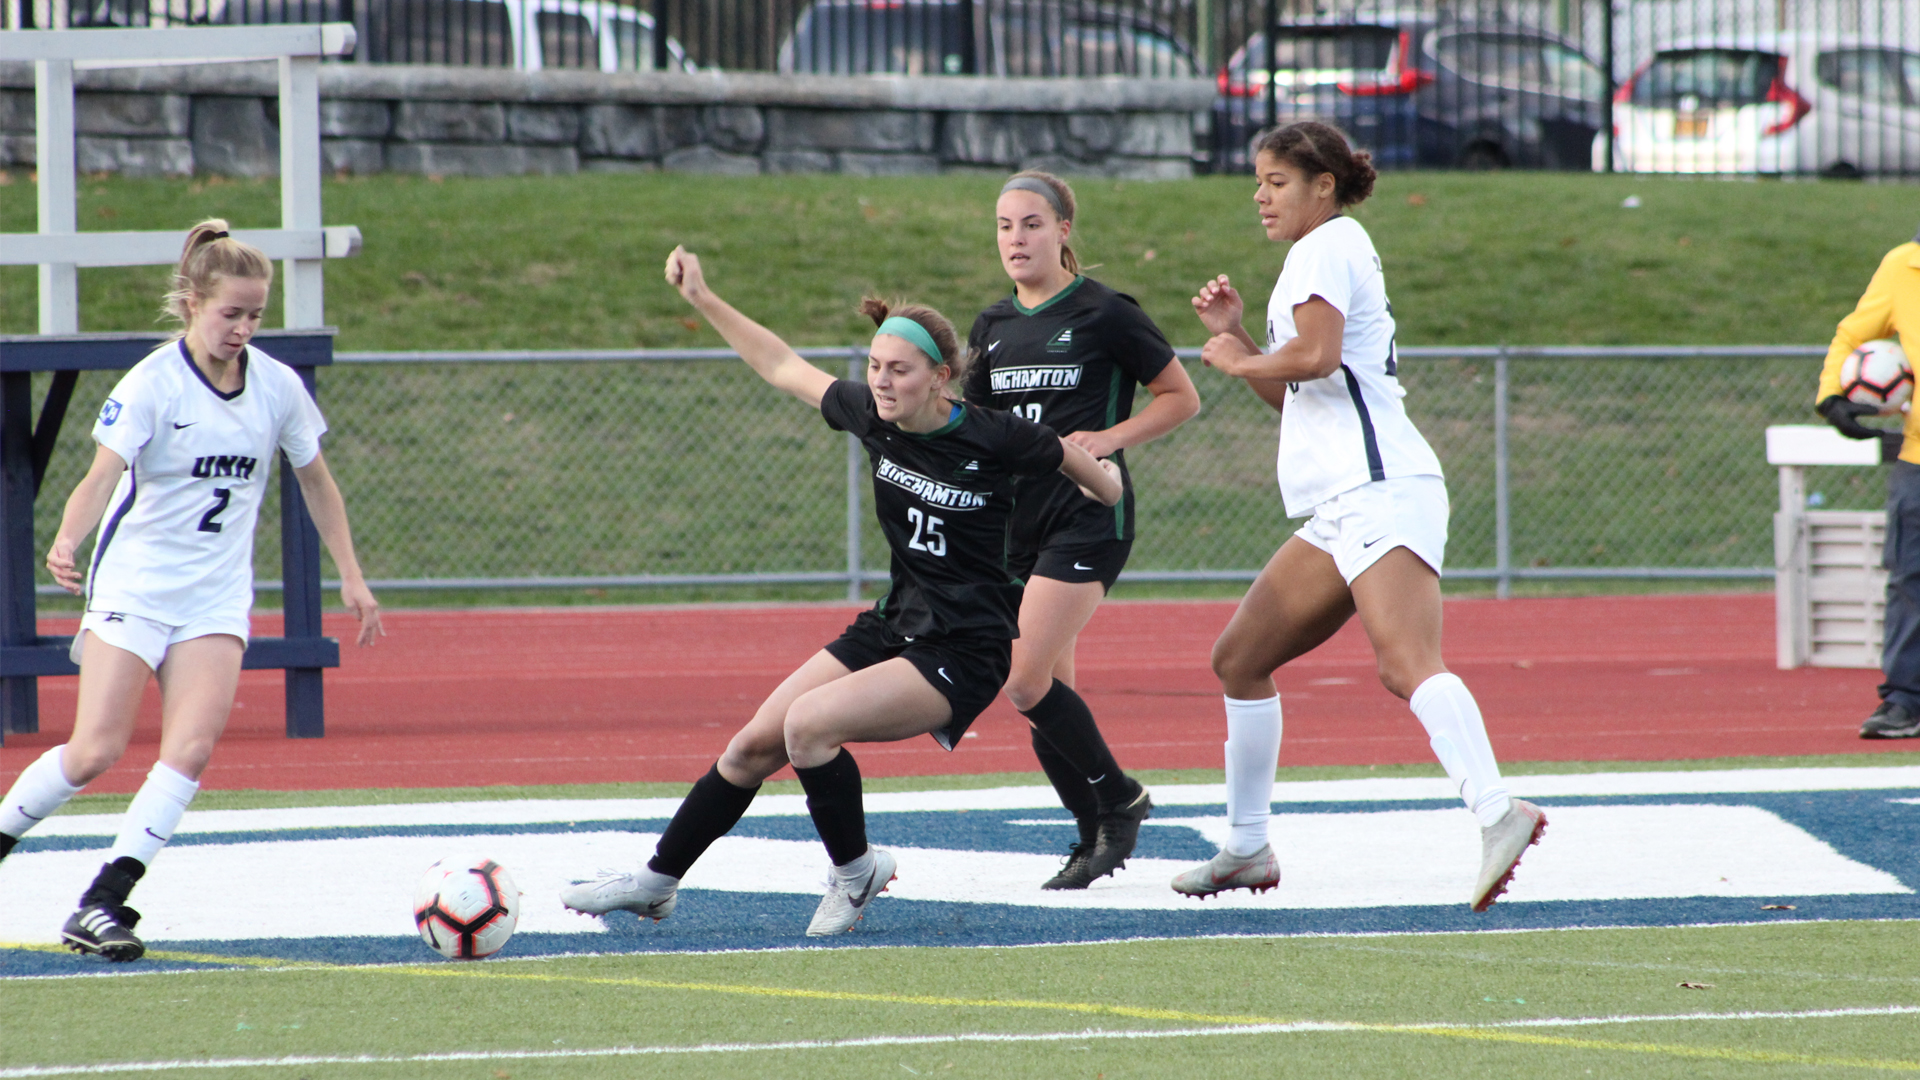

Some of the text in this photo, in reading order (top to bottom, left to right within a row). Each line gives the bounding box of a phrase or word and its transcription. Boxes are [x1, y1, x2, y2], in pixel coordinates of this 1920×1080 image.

[990, 368, 1079, 391] INGHAMTON
[191, 455, 257, 480] UNH
[198, 488, 231, 533] 2
[907, 507, 946, 557] 25
